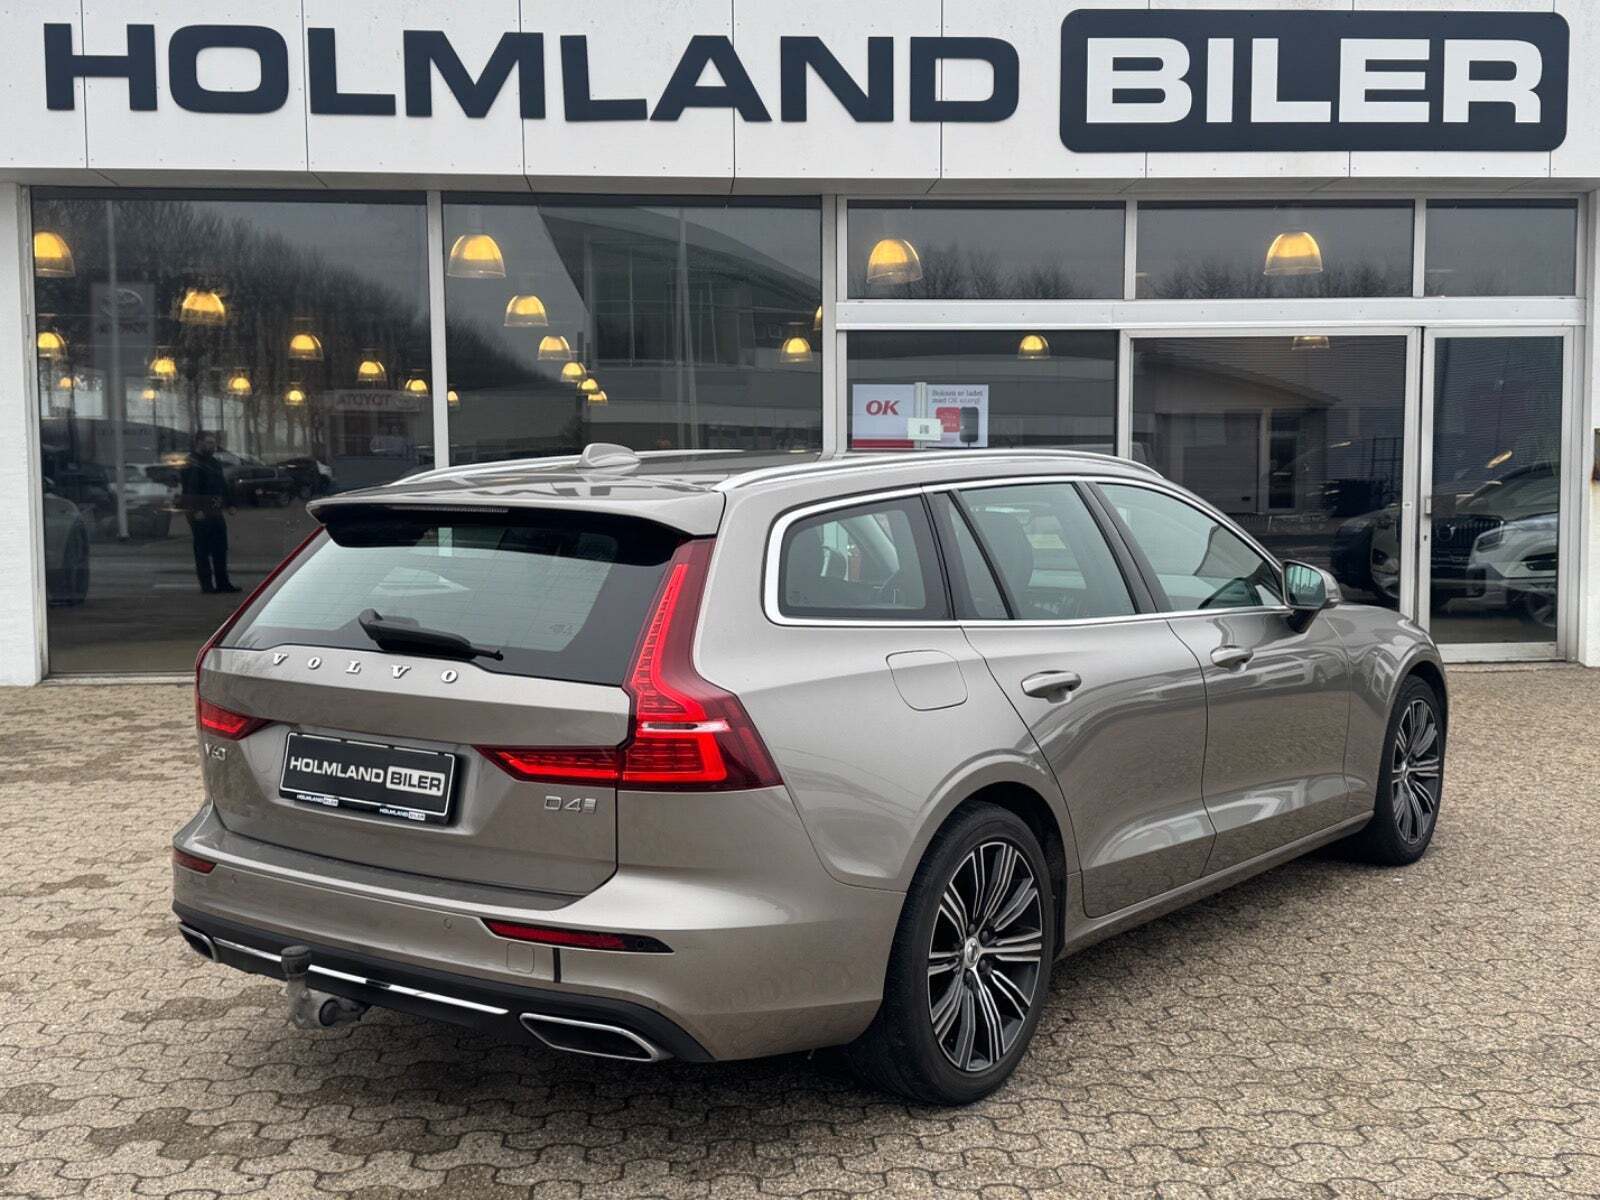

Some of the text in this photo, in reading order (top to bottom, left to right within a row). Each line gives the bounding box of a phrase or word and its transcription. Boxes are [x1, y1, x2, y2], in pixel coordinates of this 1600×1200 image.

[44, 22, 1543, 124] HOLMLAND BILER
[866, 400, 900, 416] OK
[272, 652, 459, 684] VOLVO
[289, 756, 443, 792] HOLMLAND BILER
[544, 795, 582, 813] D4
